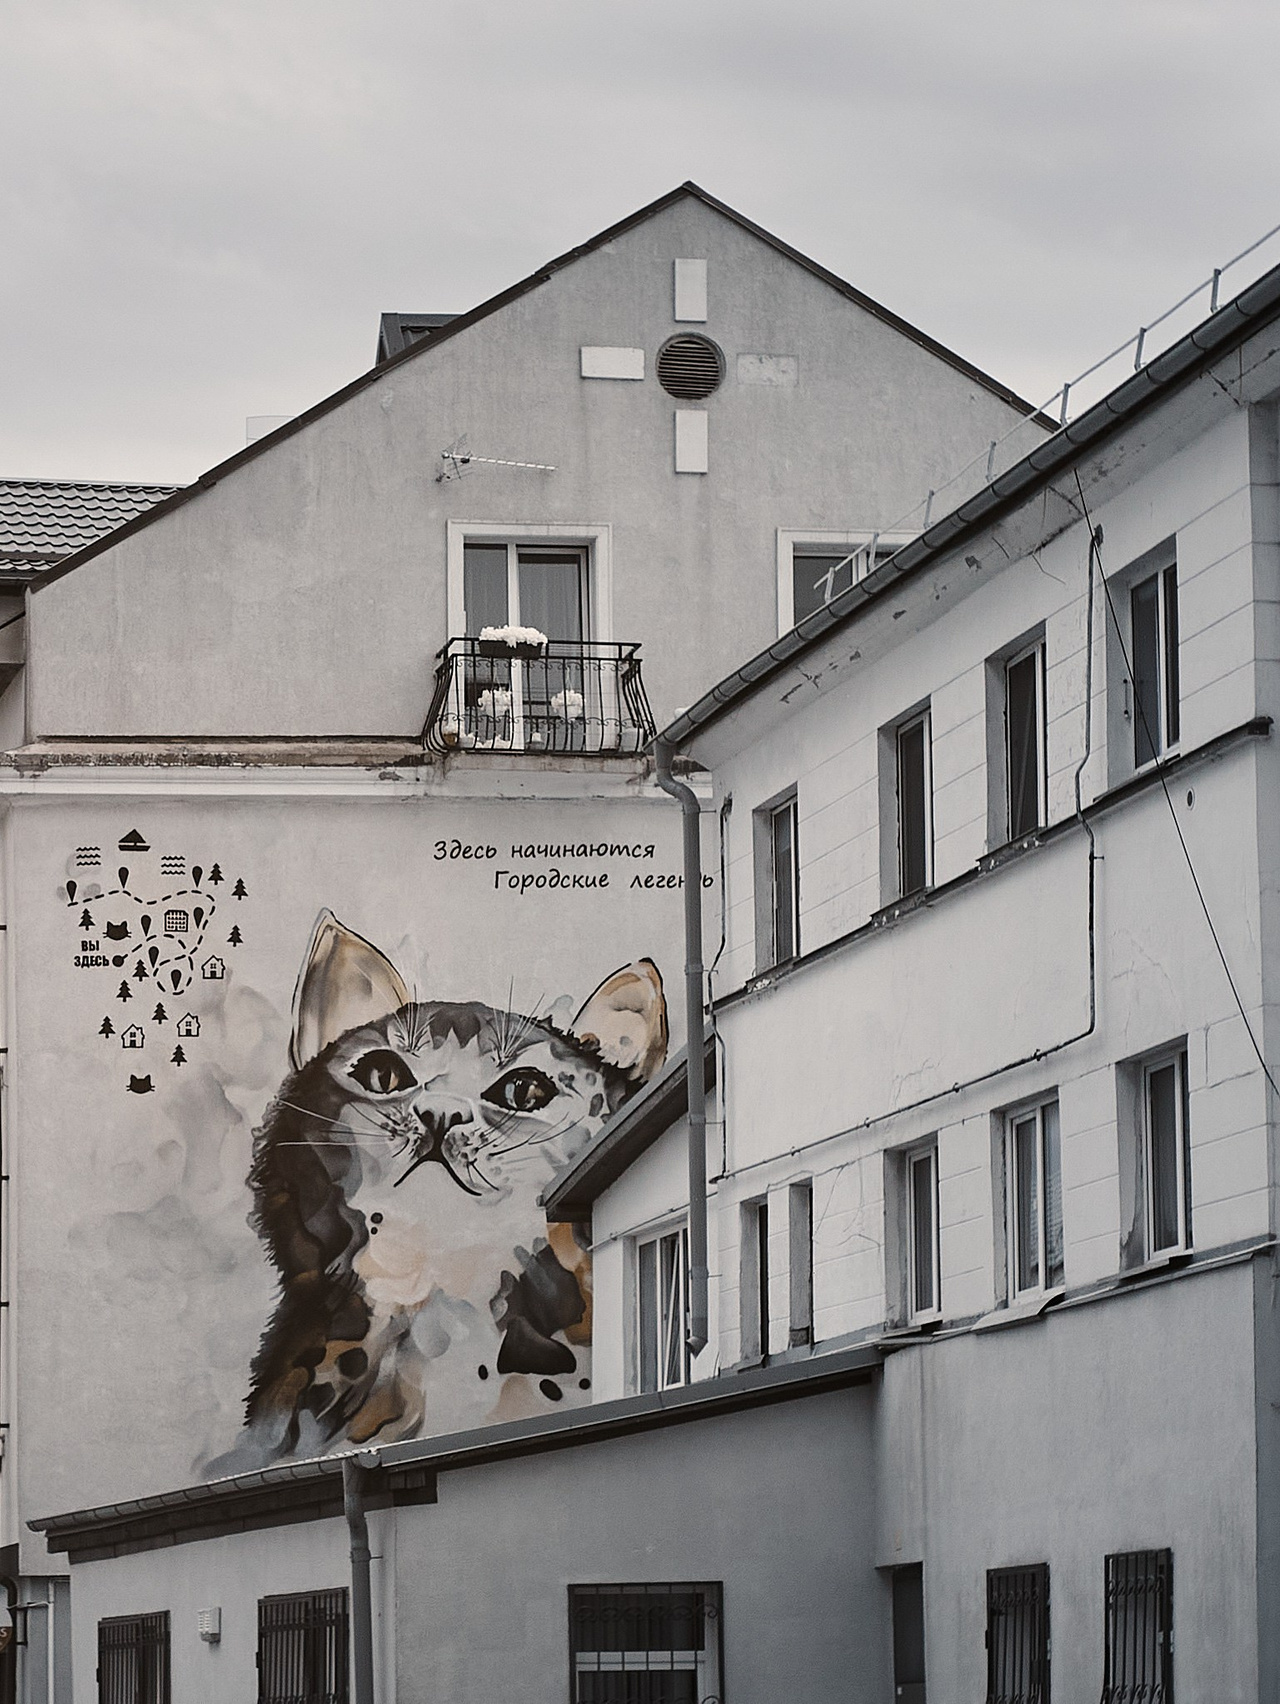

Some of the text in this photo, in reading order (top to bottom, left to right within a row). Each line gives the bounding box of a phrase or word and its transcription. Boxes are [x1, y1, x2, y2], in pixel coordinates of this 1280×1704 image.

[433, 839, 656, 861] Здесь начинаются
[493, 868, 610, 896] Городские
[81, 939, 100, 952] ВЫ
[73, 954, 110, 969] ЗДЕСЬ
